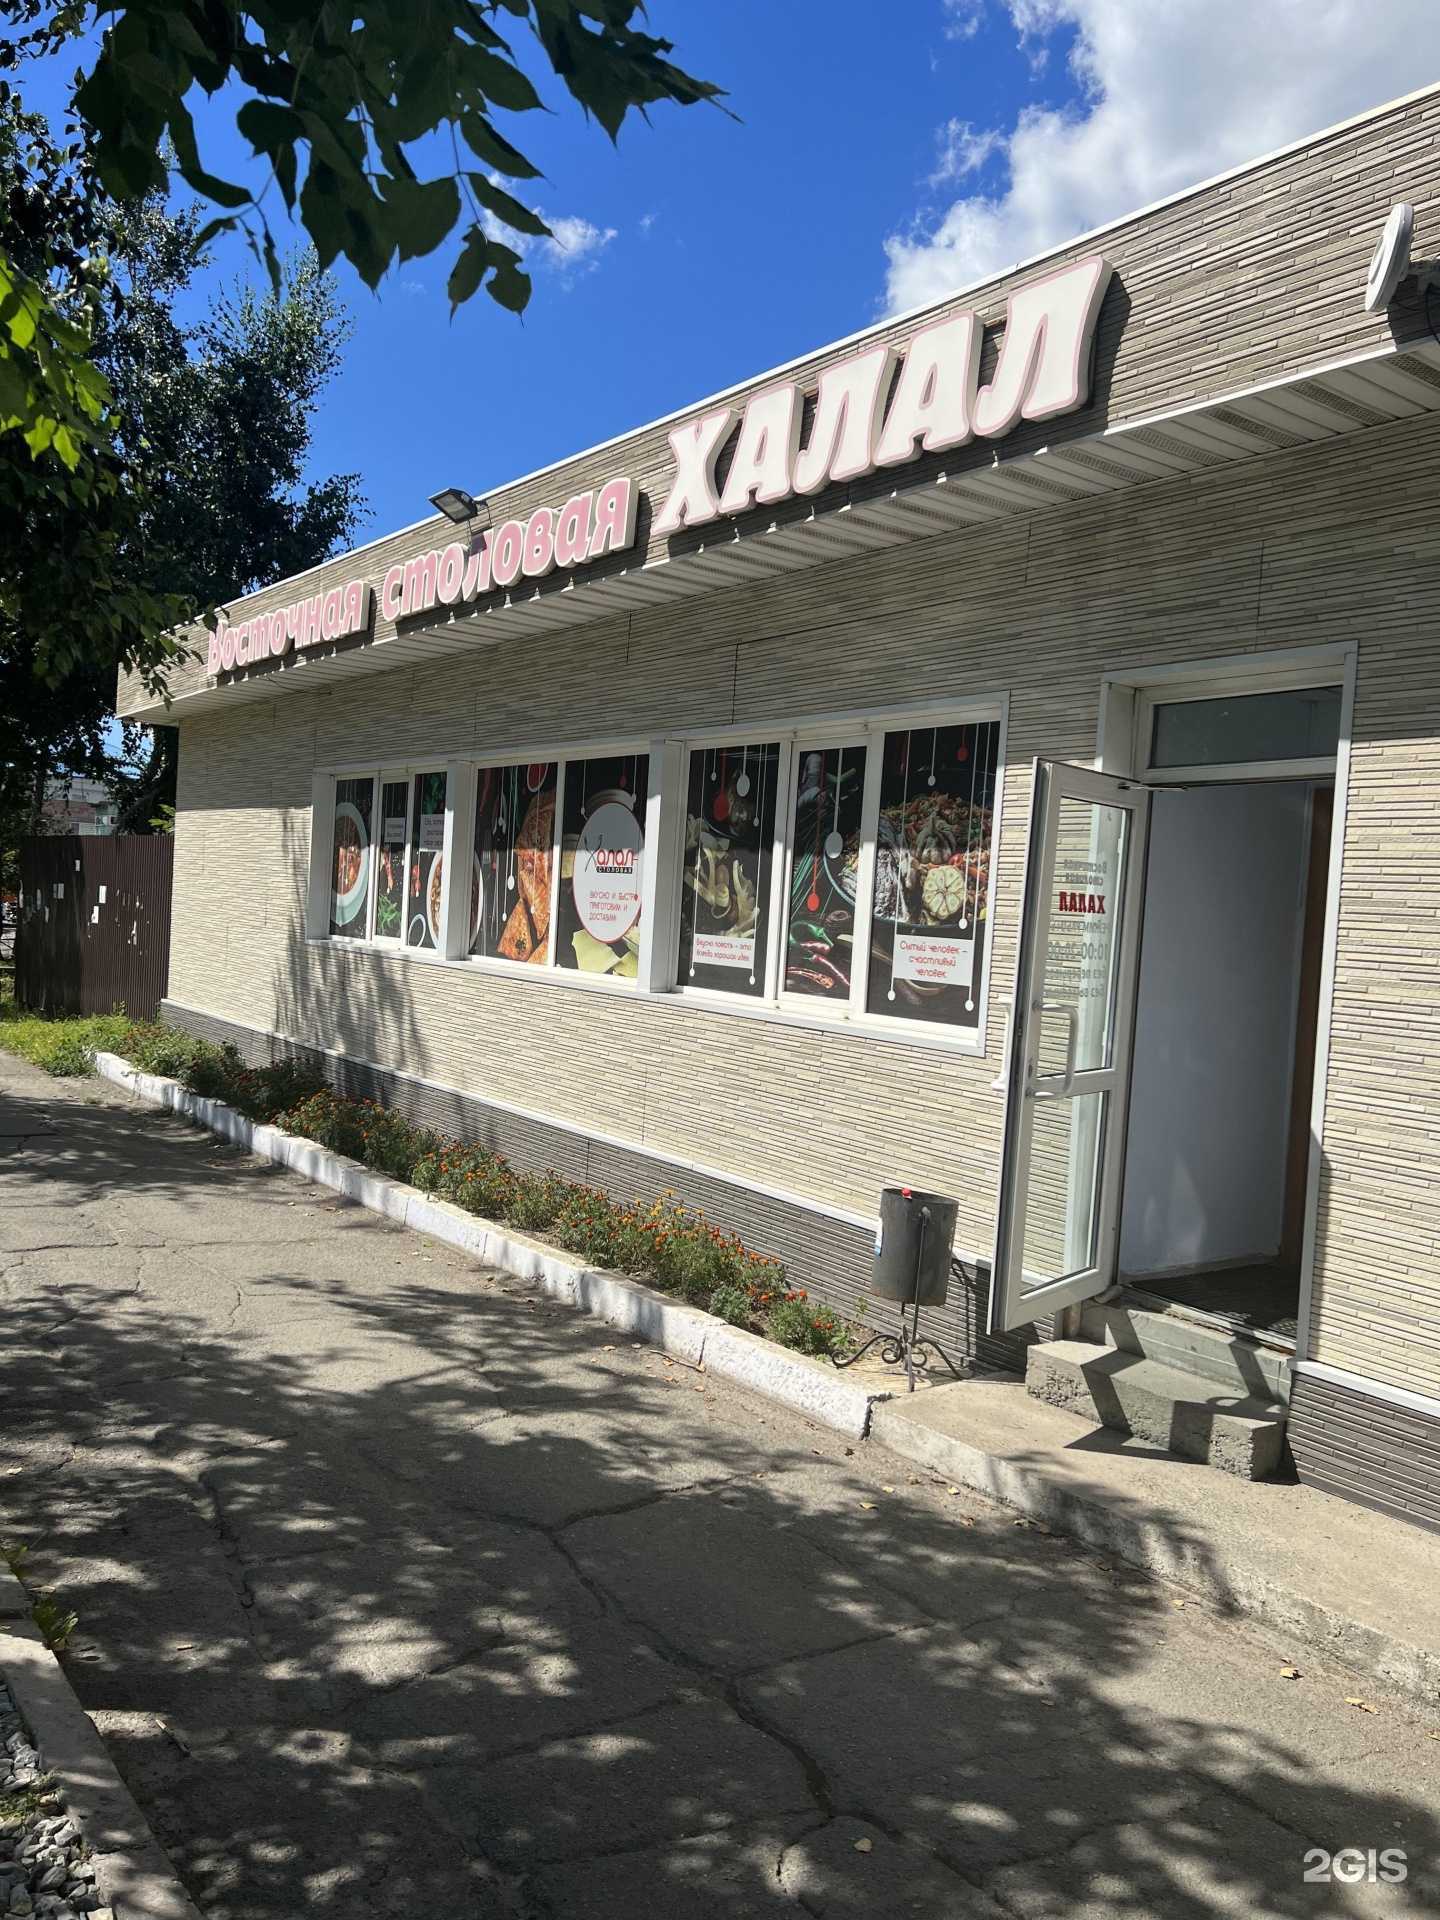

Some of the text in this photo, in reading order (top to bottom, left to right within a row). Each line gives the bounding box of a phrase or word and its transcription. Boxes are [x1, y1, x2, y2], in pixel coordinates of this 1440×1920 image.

[207, 256, 1112, 676] Восточная столовая ХАЛАЛ
